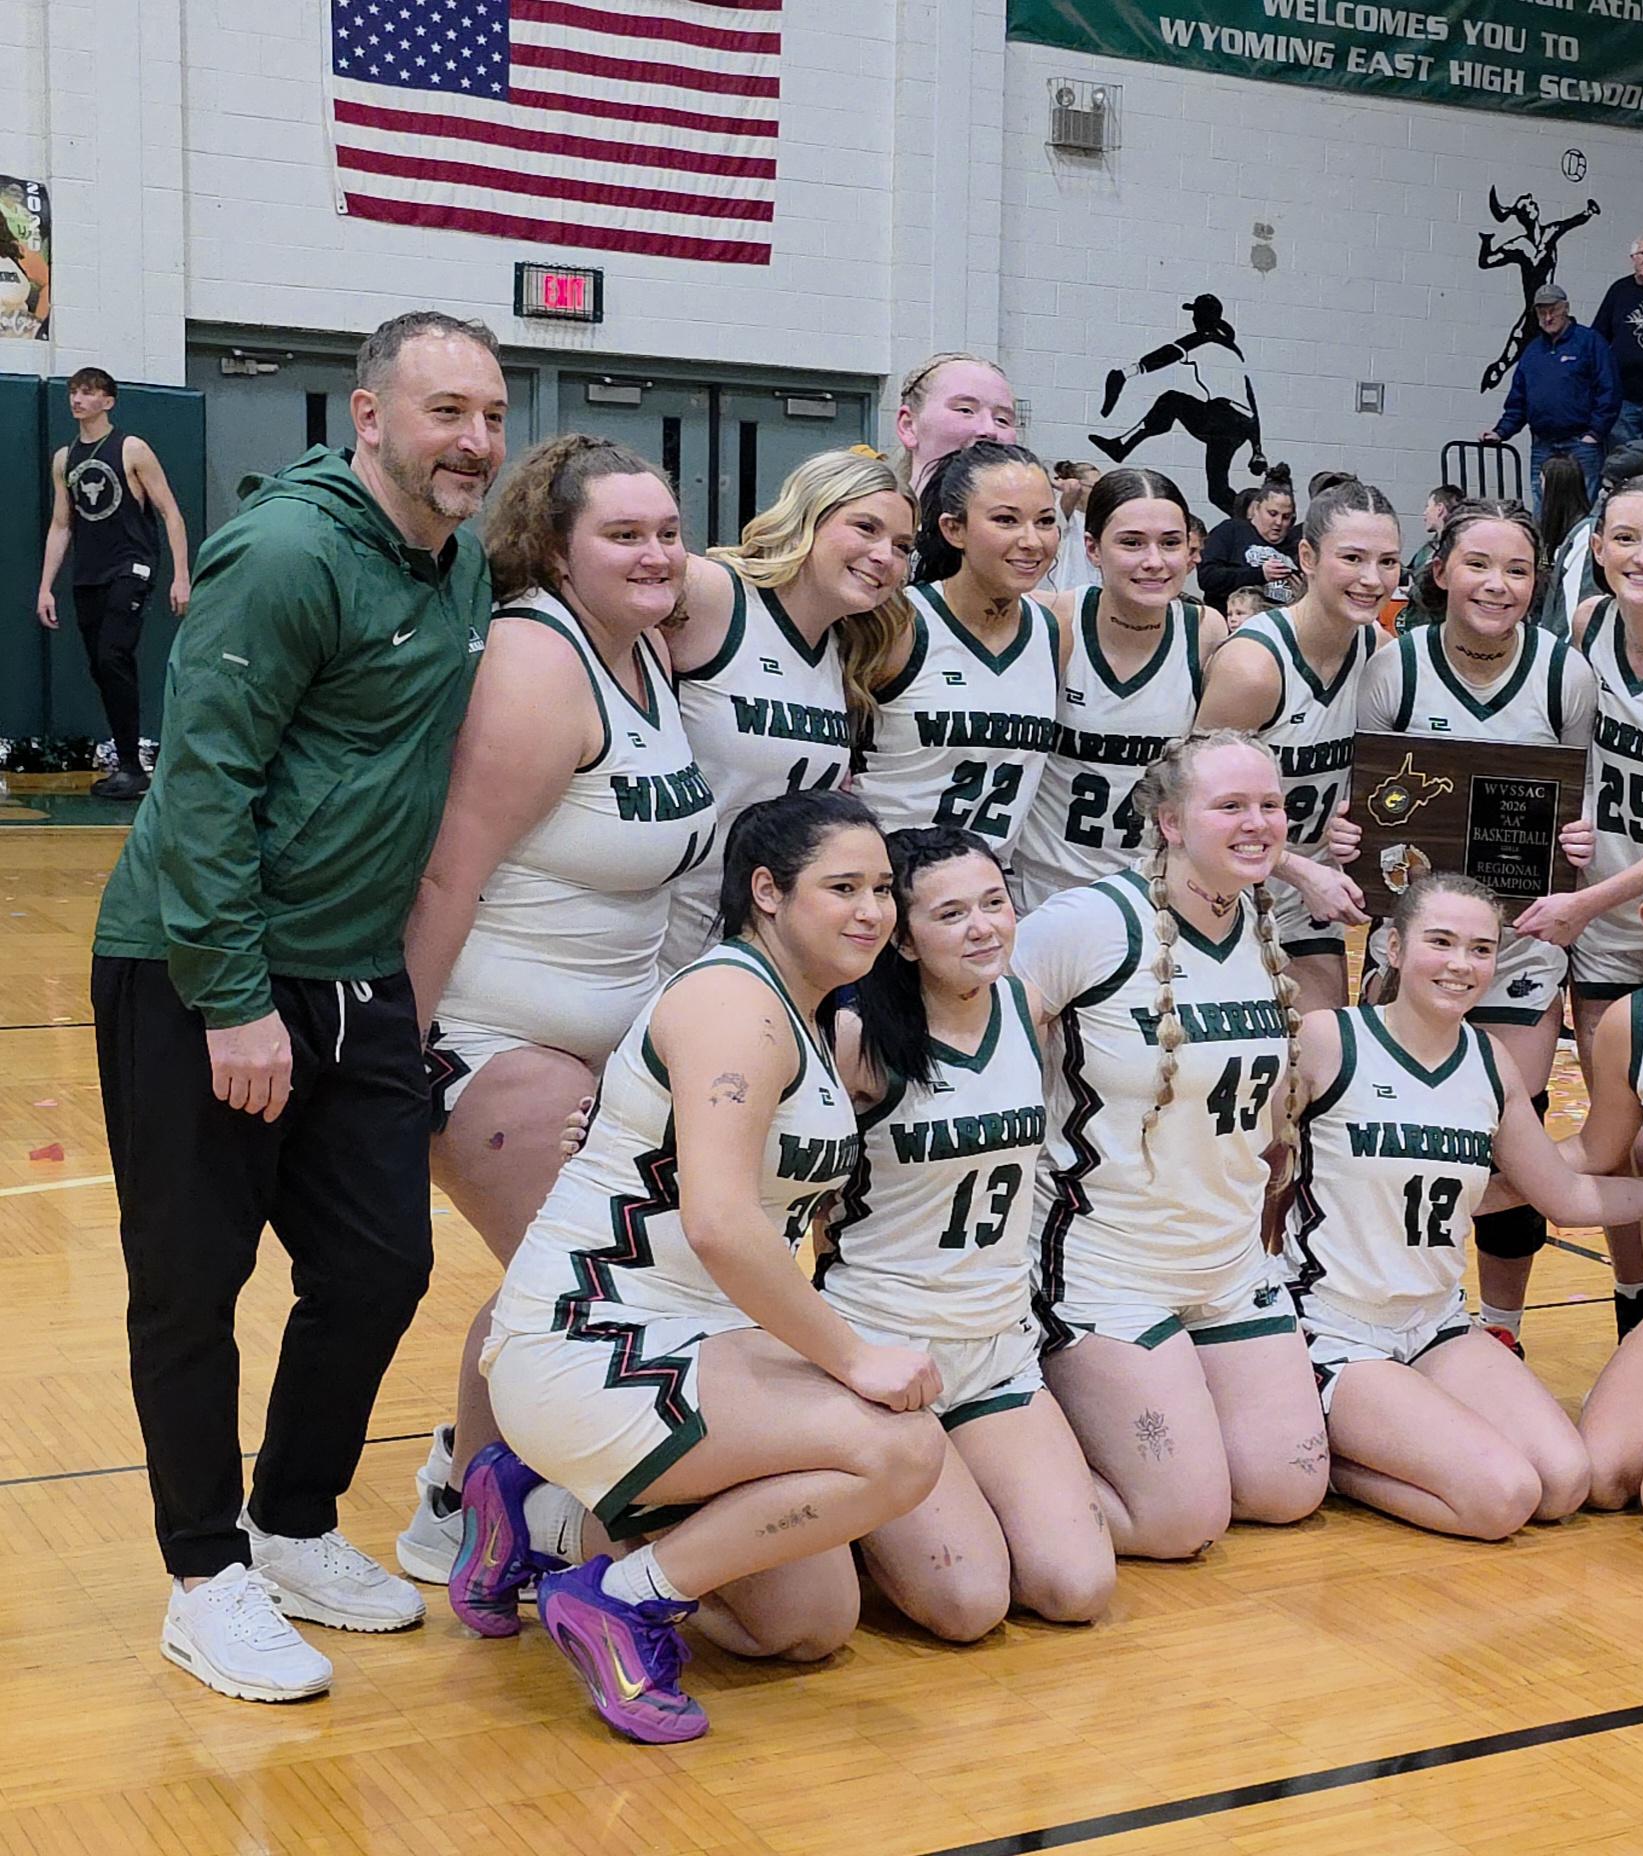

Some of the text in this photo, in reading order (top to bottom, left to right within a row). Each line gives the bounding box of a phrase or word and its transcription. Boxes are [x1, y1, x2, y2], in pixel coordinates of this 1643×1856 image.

[1159, 16, 1336, 70] WYOMING
[1346, 46, 1434, 81] EAST
[1449, 59, 1526, 95] HIGH
[1263, 0, 1580, 62] WELCOMES YOU TO
[544, 273, 585, 313] EXIT
[931, 759, 1025, 839] 22
[1064, 772, 1146, 849] 24
[1484, 782, 1545, 799] WVSSAC
[1499, 800, 1527, 812] 2026
[1472, 827, 1549, 846] BASKETBALL
[1477, 861, 1541, 877] REGIONAL
[1207, 1055, 1280, 1137] 43
[938, 1163, 1023, 1249] 13
[1403, 1174, 1463, 1248] 12
